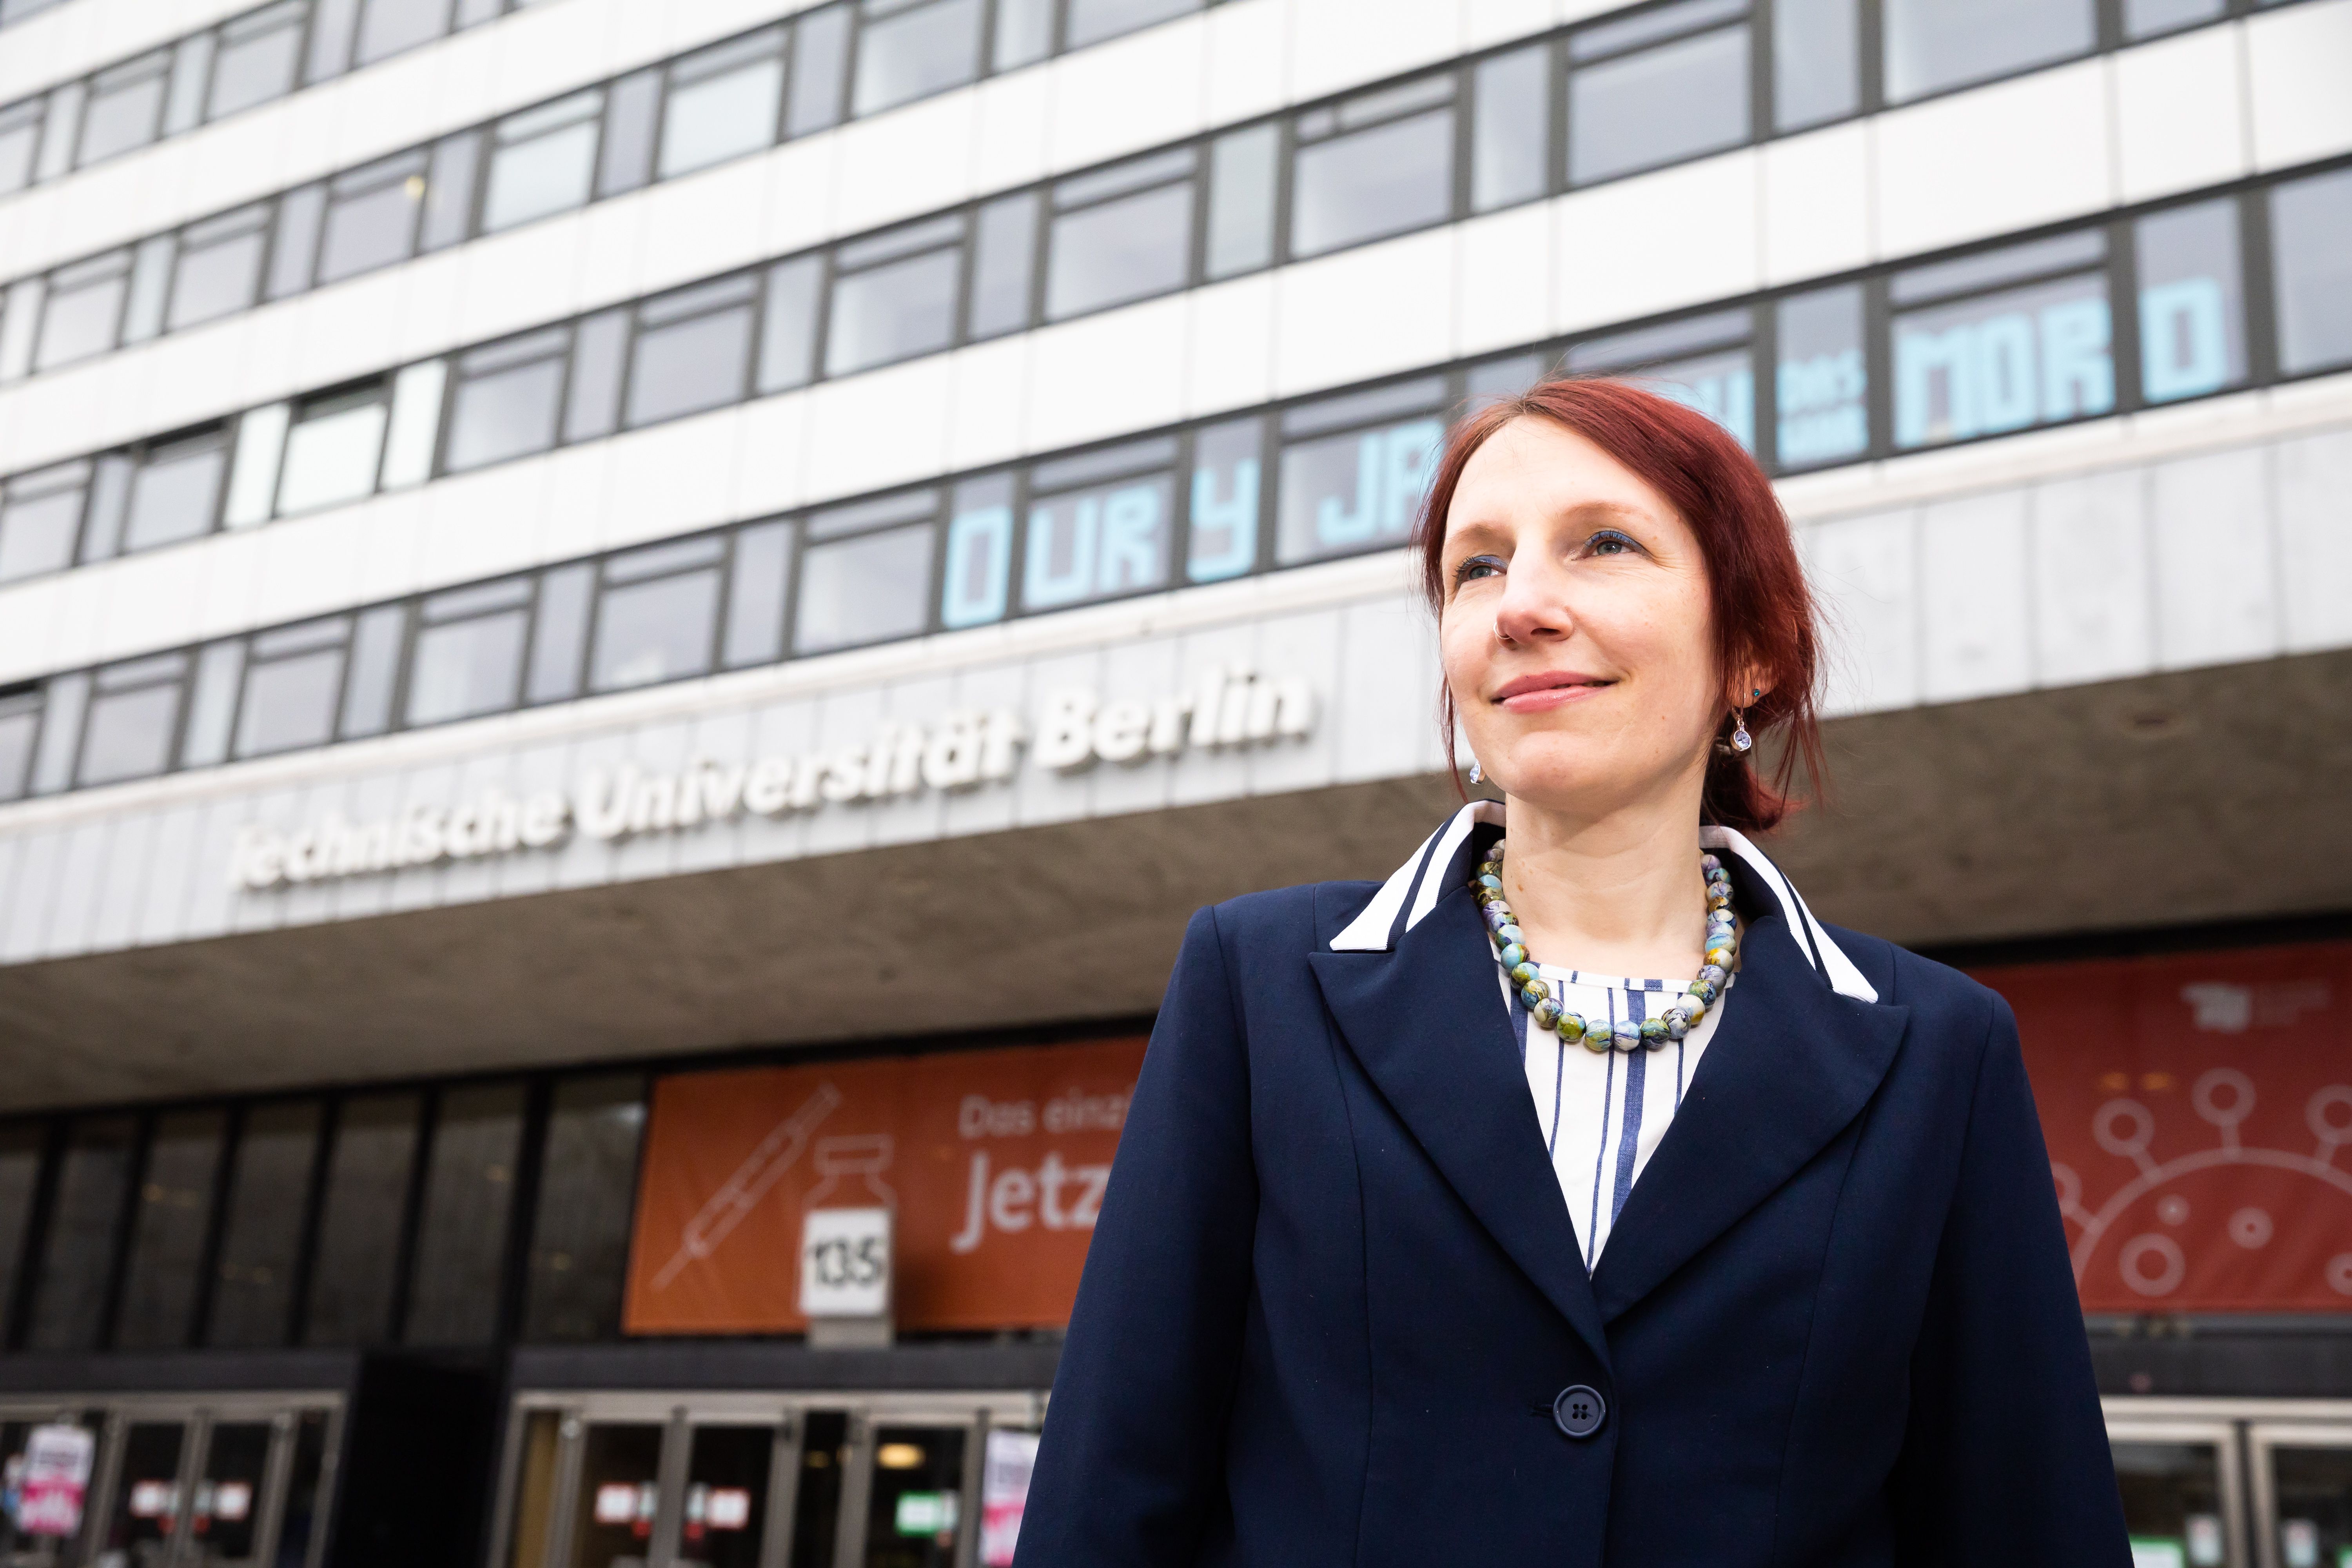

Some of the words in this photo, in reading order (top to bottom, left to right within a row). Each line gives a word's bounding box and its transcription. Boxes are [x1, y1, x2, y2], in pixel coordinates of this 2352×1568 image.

[578, 709, 1025, 839] Universität
[1031, 664, 1318, 775] Berlin
[958, 1094, 1037, 1139] Das
[949, 1149, 1112, 1254] Jetz
[810, 1235, 883, 1289] 135
